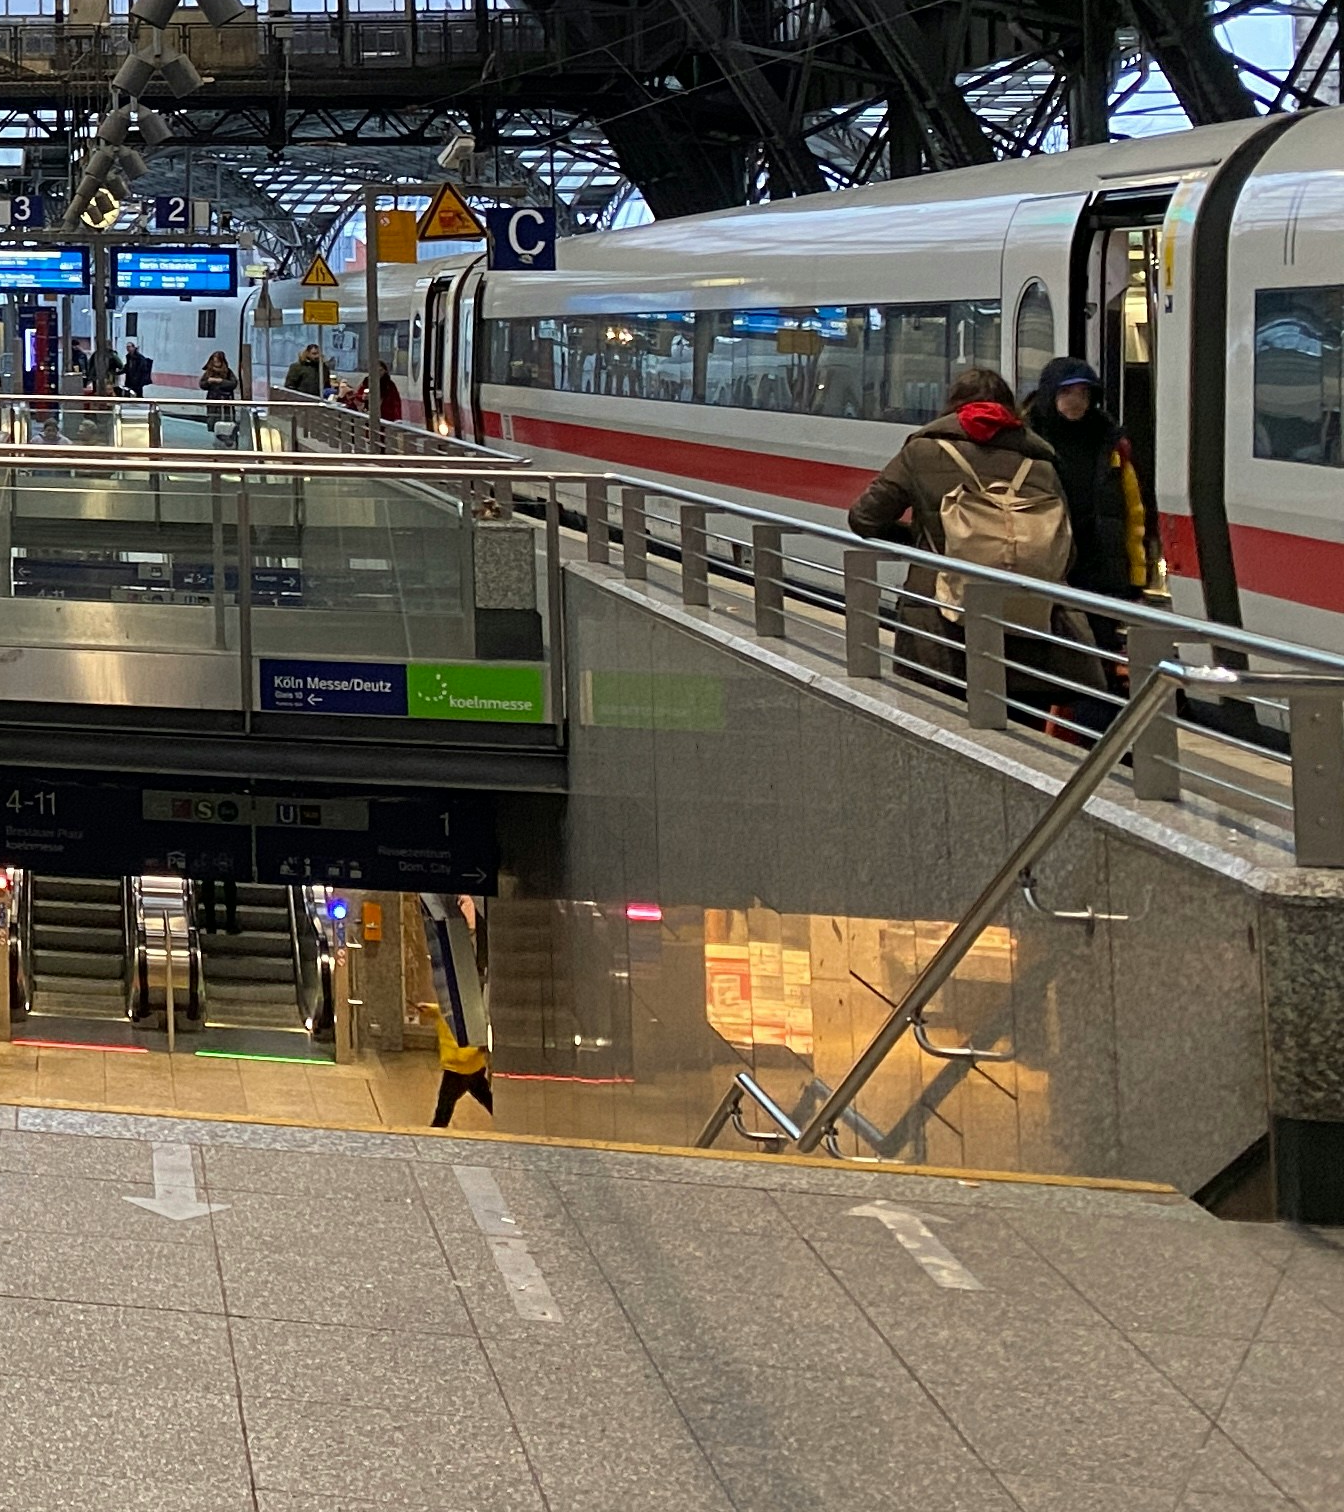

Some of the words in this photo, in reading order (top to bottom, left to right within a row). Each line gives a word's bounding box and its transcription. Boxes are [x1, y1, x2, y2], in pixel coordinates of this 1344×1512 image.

[13, 195, 31, 221] 3
[167, 197, 185, 222] 2
[507, 208, 546, 256] C
[956, 319, 967, 365] 1
[273, 674, 304, 690] Köln
[306, 676, 393, 694] Messe/Deutz
[449, 695, 533, 711] koelnmesse
[5, 790, 56, 816] 4-11
[279, 805, 294, 823] U
[439, 812, 450, 837] 1
